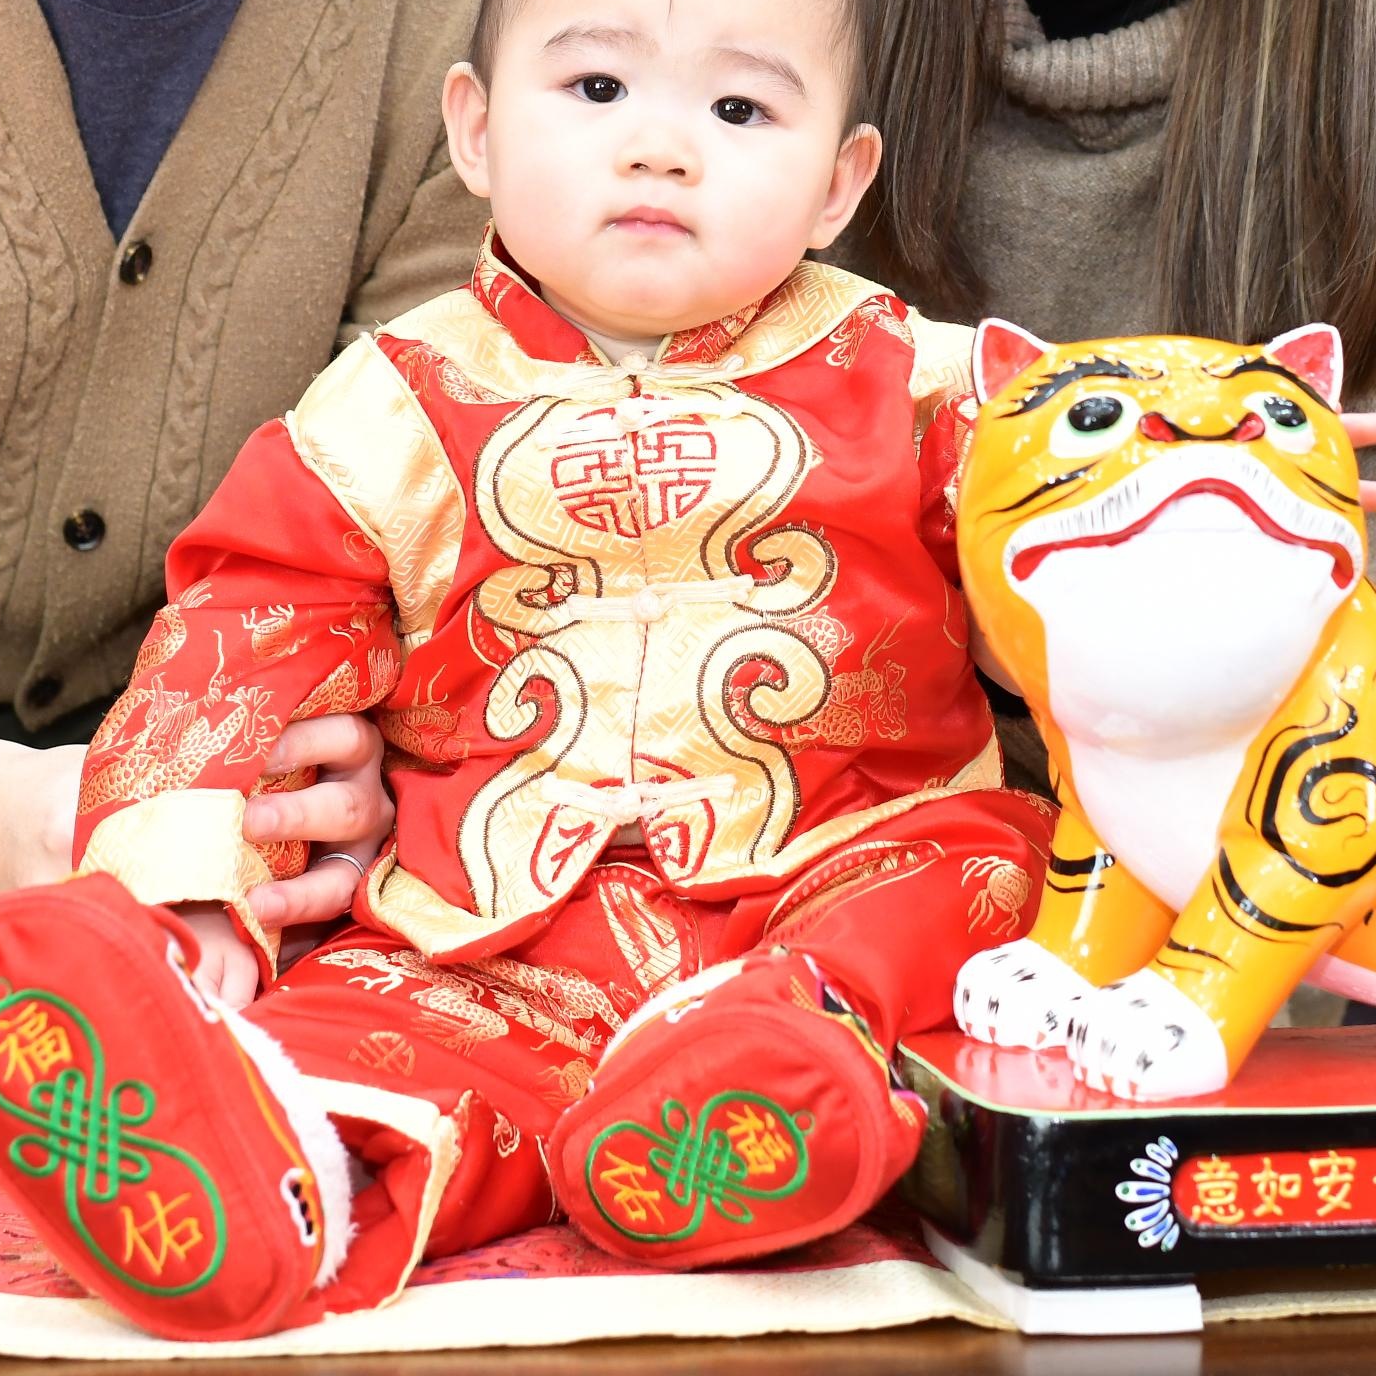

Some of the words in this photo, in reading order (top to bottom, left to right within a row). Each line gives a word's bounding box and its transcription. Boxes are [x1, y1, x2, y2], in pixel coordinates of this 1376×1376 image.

[725, 1104, 794, 1175] 福
[599, 1150, 665, 1225] 佑
[119, 1189, 205, 1276] 佑
